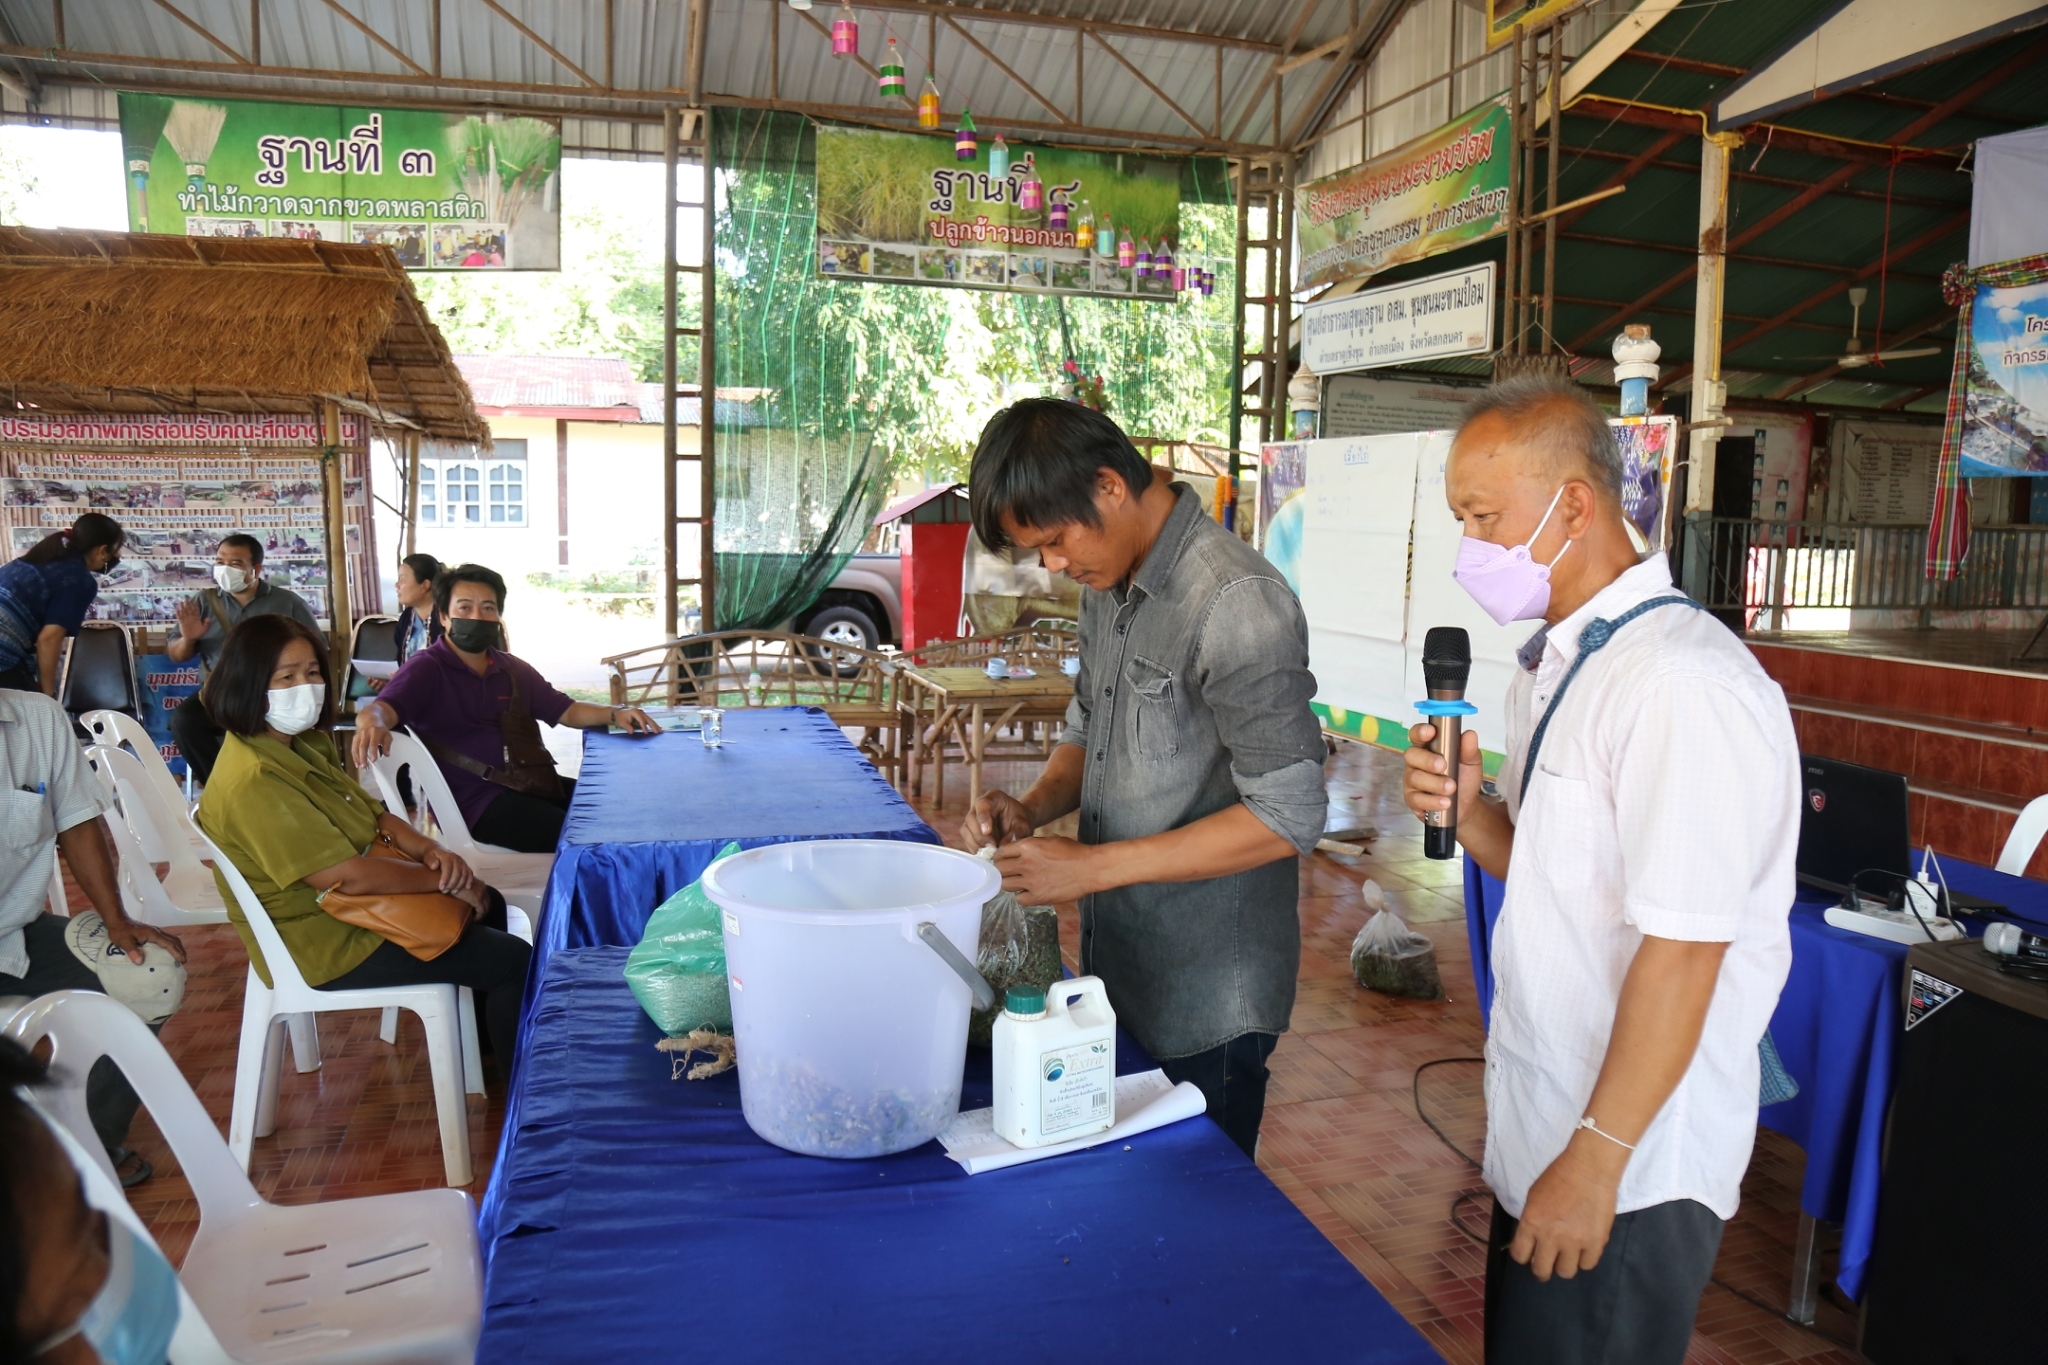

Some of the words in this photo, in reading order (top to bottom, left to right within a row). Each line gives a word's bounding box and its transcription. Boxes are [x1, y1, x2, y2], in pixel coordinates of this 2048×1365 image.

[258, 113, 382, 186] ฐานที่
[401, 148, 435, 176] ๓
[178, 185, 487, 219] ทำไม้กวาดจากขวดพลาสติก
[1427, 184, 1508, 236] นำการพัฒนา
[930, 215, 1077, 248] ปลูกข้าวนอกนา
[1307, 303, 1384, 347] ศูนย์สาธารณสุขมูลฐาน
[1387, 300, 1407, 322] อสม.
[1411, 276, 1485, 328] ชุมชนมะขามป้อม
[1410, 330, 1464, 351] จังหวัดสกลนคร
[2003, 350, 2048, 366] กิจกรร
[1070, 1056, 1103, 1072] Extra
